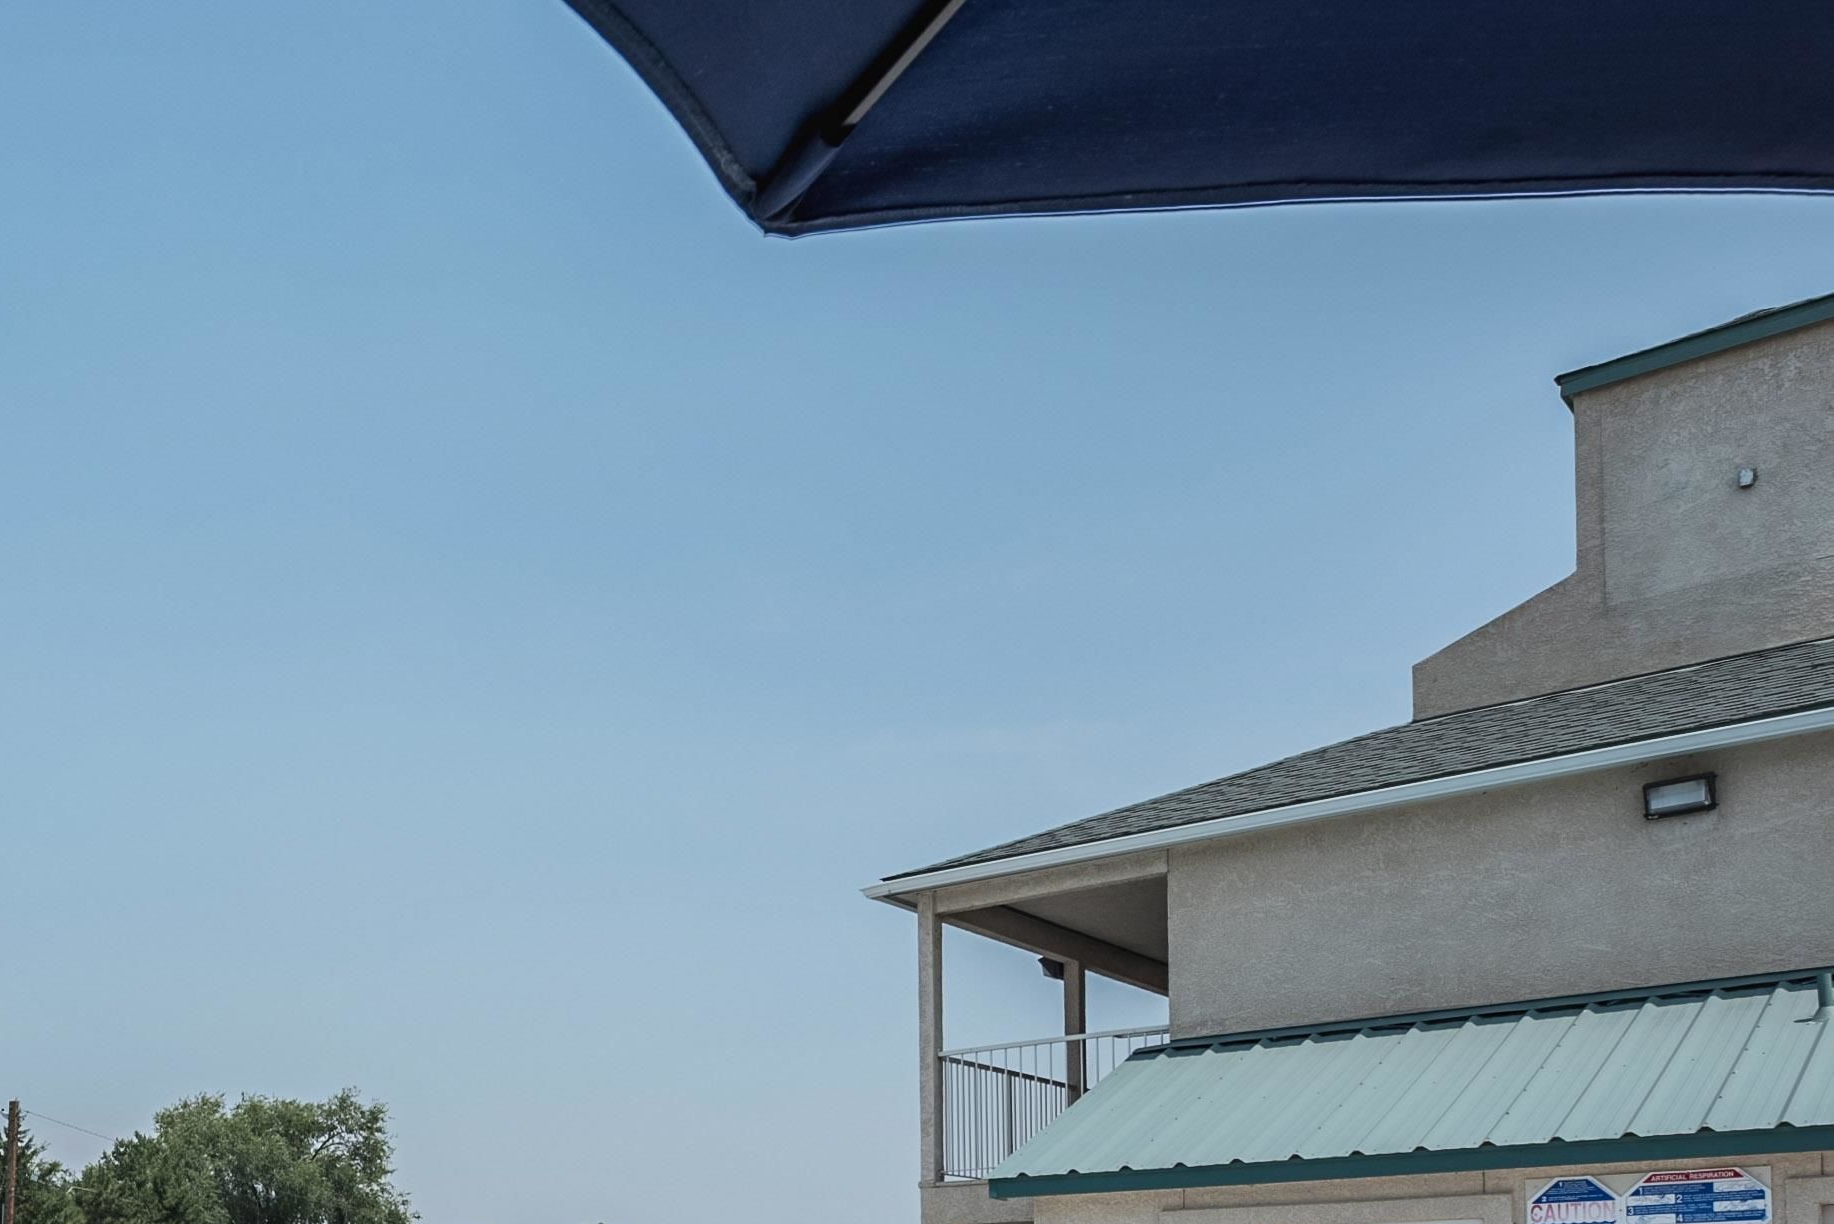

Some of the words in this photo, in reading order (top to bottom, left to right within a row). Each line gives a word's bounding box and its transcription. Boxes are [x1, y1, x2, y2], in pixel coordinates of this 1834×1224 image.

[1650, 1174, 1687, 1182] ARTIFICIAL
[1689, 1171, 1734, 1179] RESPIRATION
[1530, 1200, 1616, 1223] CAUTION
[1627, 1206, 1634, 1215] 3
[1676, 1214, 1683, 1222] 4
